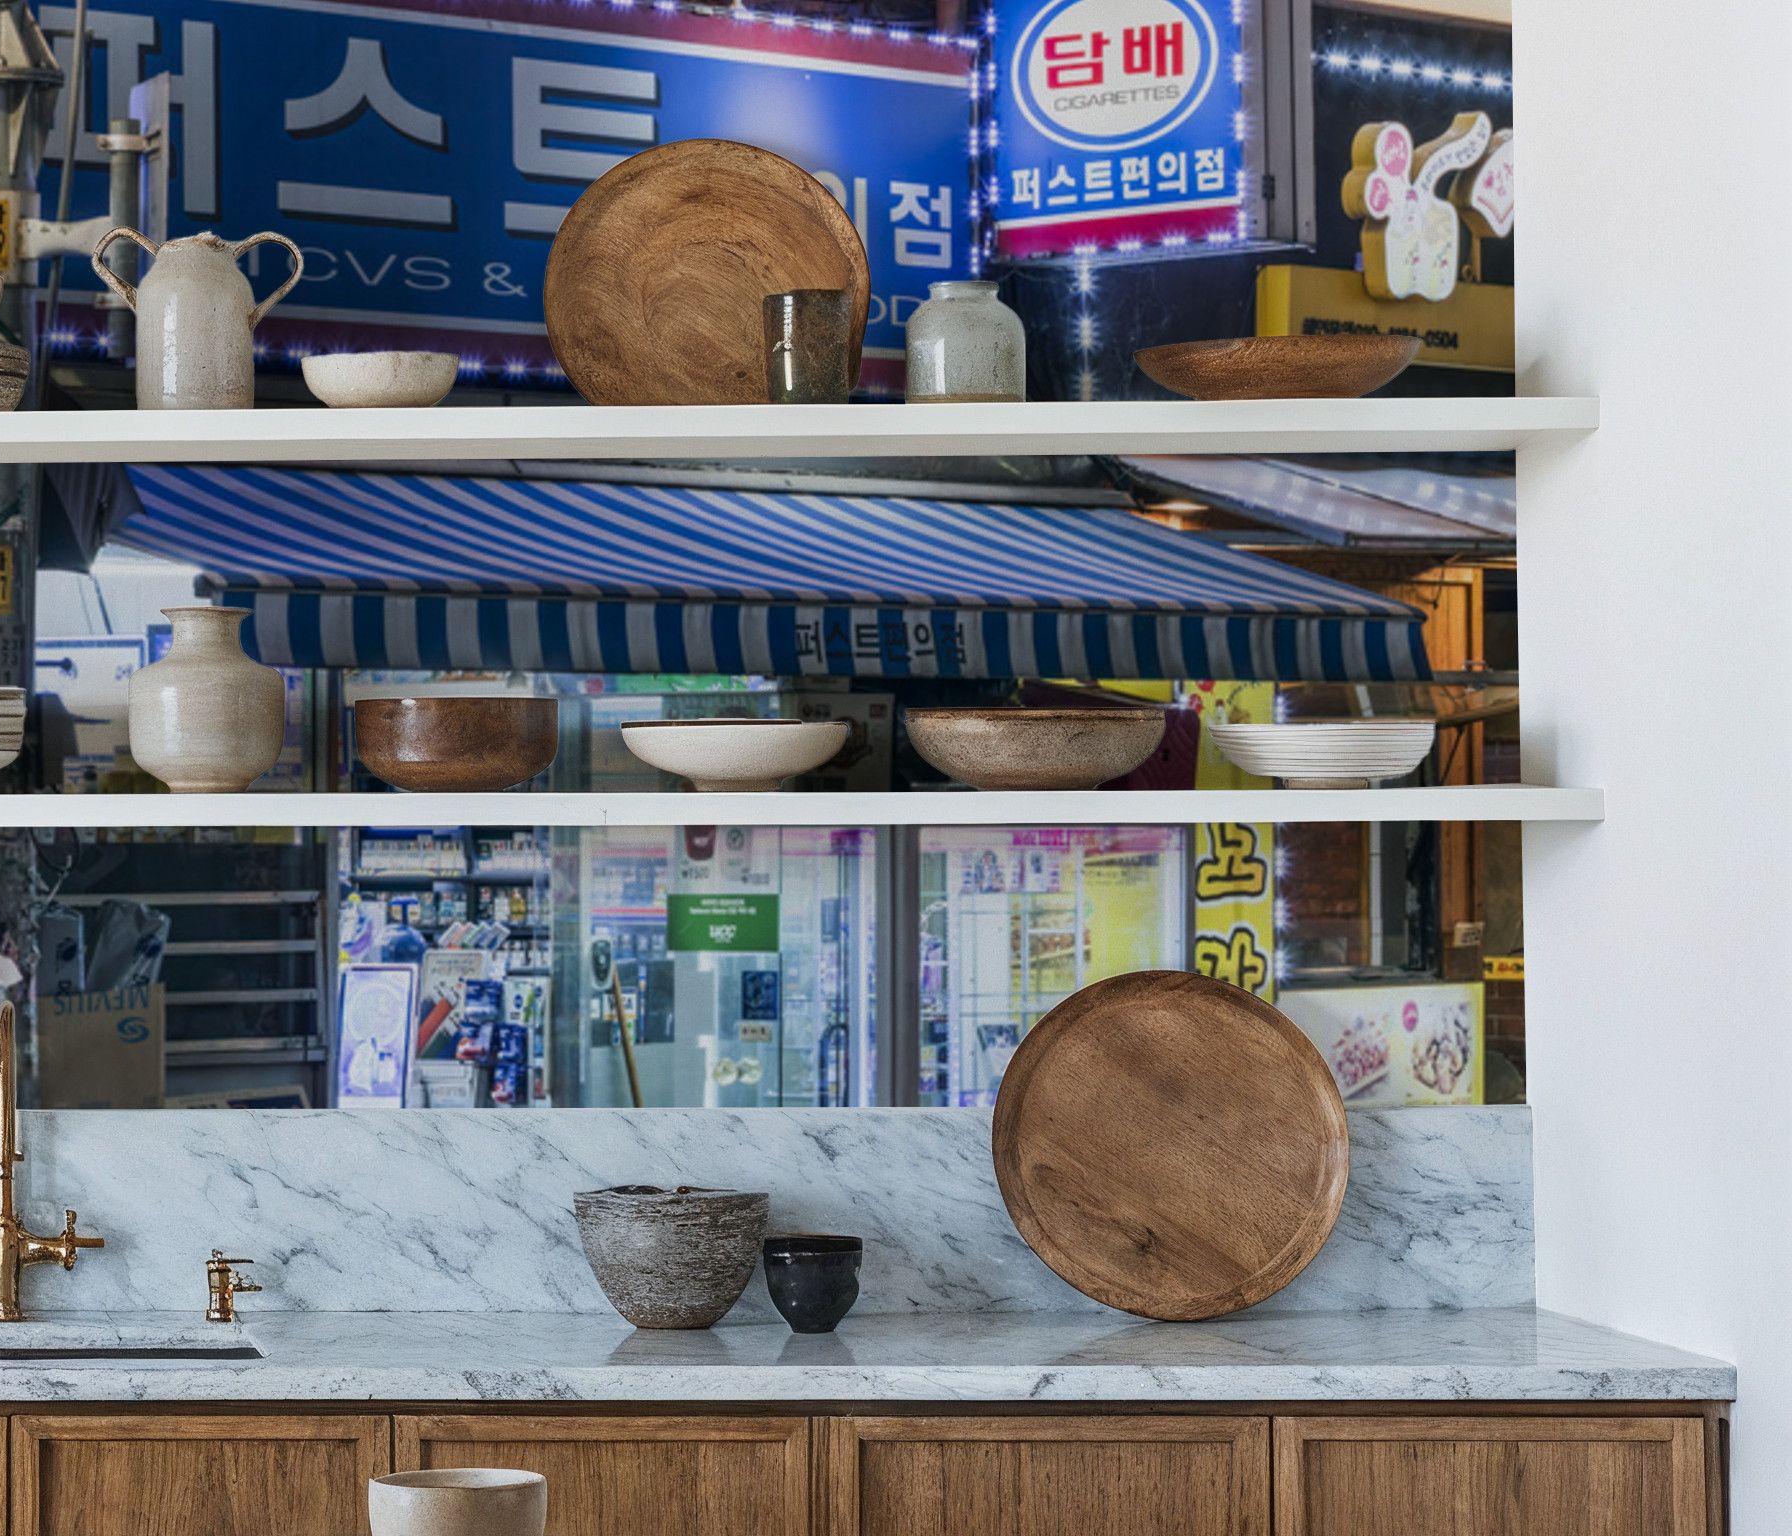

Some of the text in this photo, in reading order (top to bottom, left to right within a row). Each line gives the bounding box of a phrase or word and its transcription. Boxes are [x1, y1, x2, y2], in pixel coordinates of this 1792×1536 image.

[1043, 21, 1185, 90] 담배
[1054, 84, 1181, 113] CIGARETTES
[482, 262, 528, 298] &
